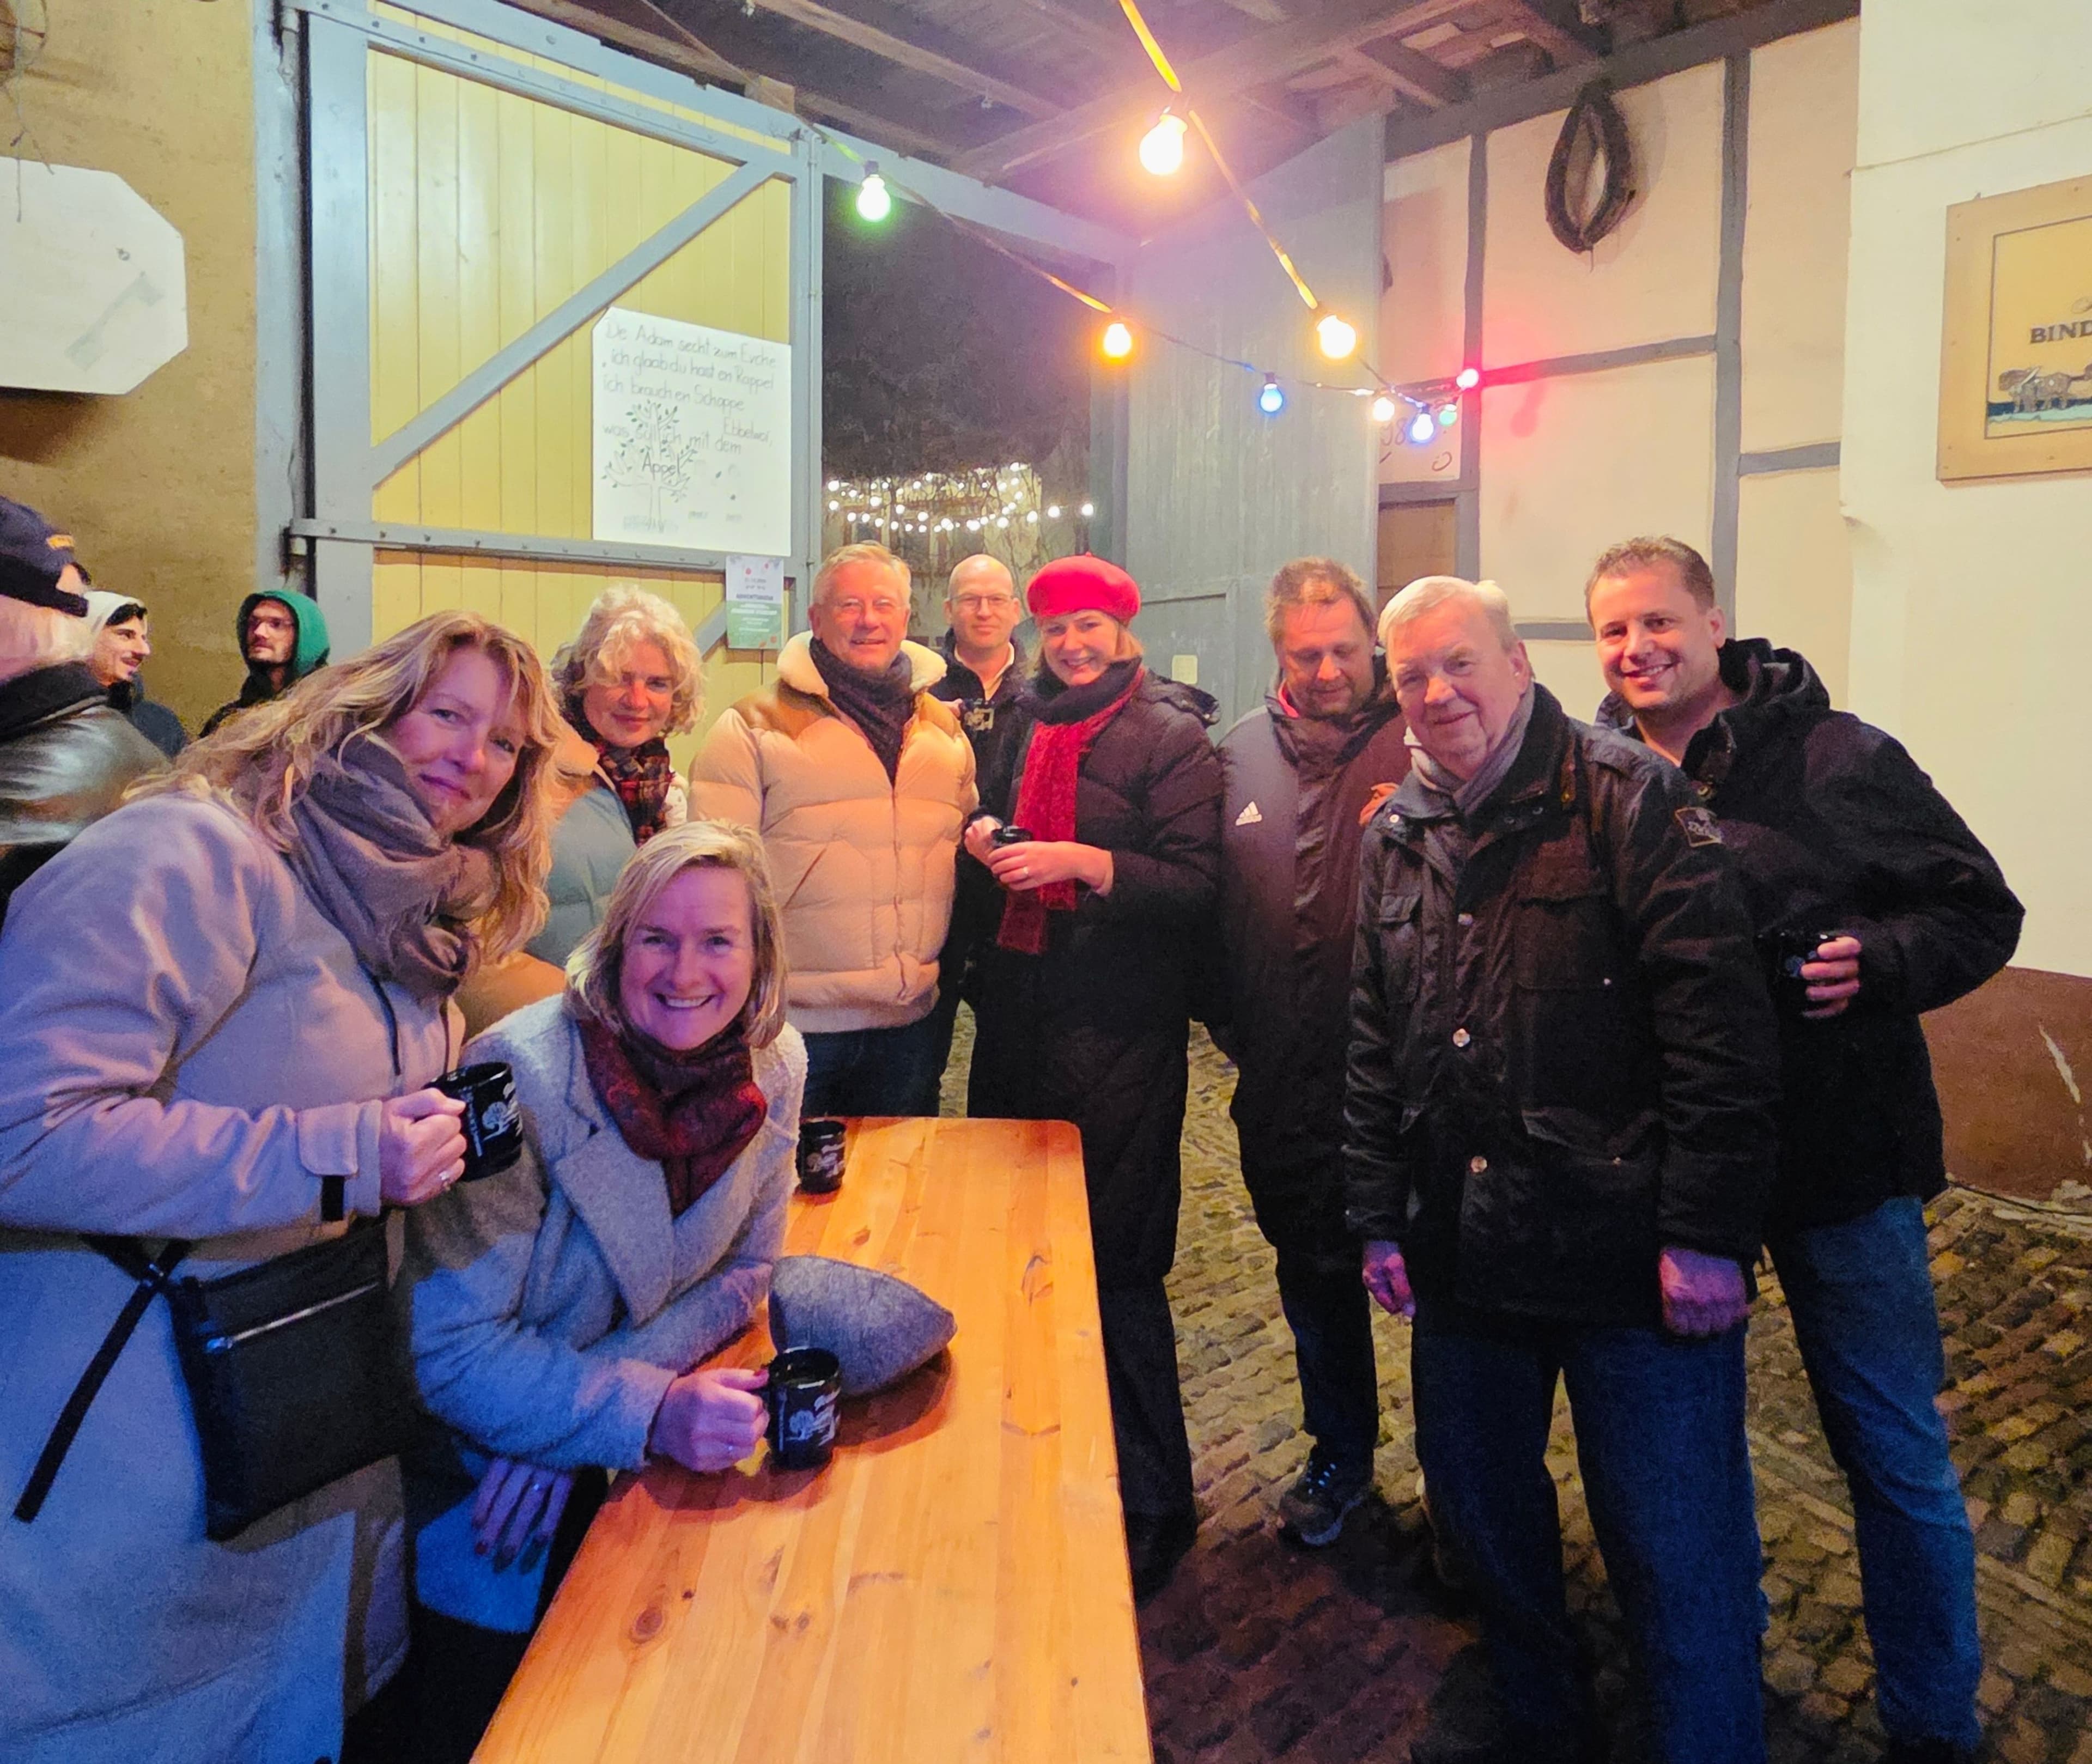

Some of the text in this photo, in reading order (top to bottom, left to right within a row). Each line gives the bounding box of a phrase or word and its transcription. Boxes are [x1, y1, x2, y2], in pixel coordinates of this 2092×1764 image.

[635, 325, 673, 347] Adam
[679, 336, 710, 355] secht
[714, 346, 737, 358] zum
[2030, 320, 2092, 344] BIND
[611, 348, 629, 366] ich
[670, 355, 687, 374] du
[690, 357, 714, 378] hast
[718, 370, 732, 382] en
[734, 365, 774, 396] Rappel
[603, 372, 623, 393] ich
[674, 391, 690, 402] en
[694, 384, 745, 416] Schoppe
[689, 430, 709, 449] mit
[715, 434, 741, 456] dem
[642, 452, 682, 480] Appel
